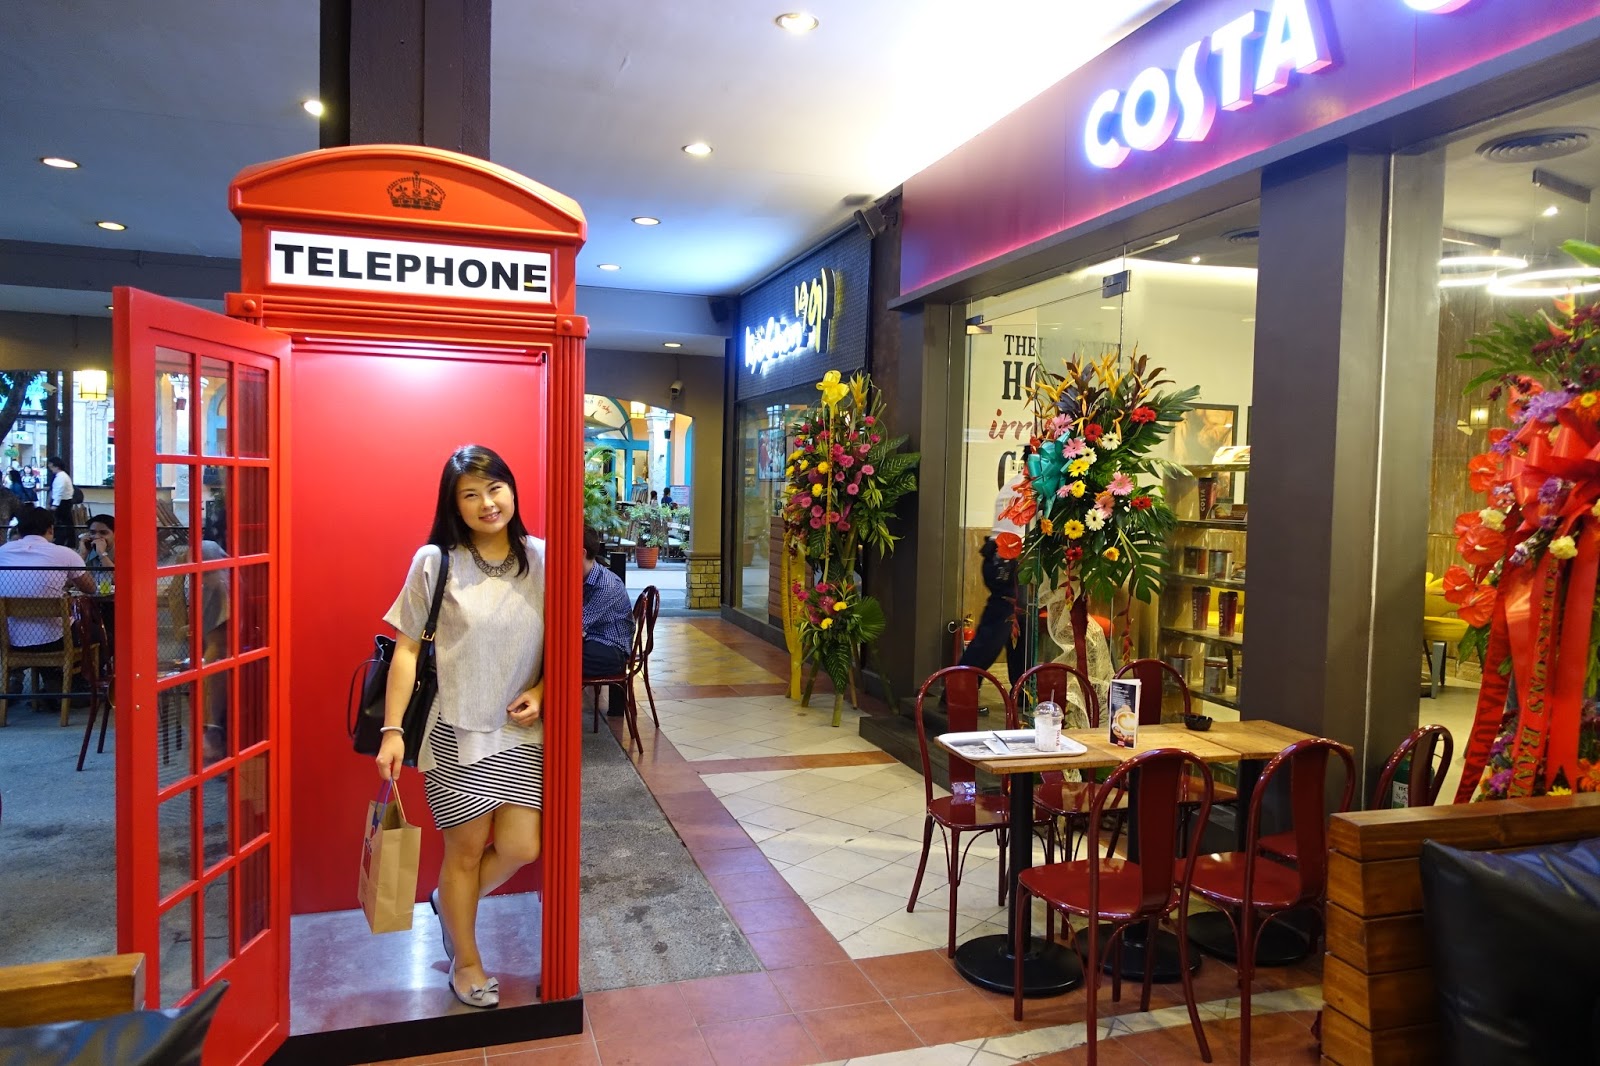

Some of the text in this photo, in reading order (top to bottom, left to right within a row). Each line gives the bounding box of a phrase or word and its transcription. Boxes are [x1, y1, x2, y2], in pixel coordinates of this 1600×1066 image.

[1083, 0, 1333, 169] COSTA
[275, 243, 547, 293] TELEPHONE
[1004, 334, 1036, 357] THE
[1199, 488, 1207, 512] COSTA
